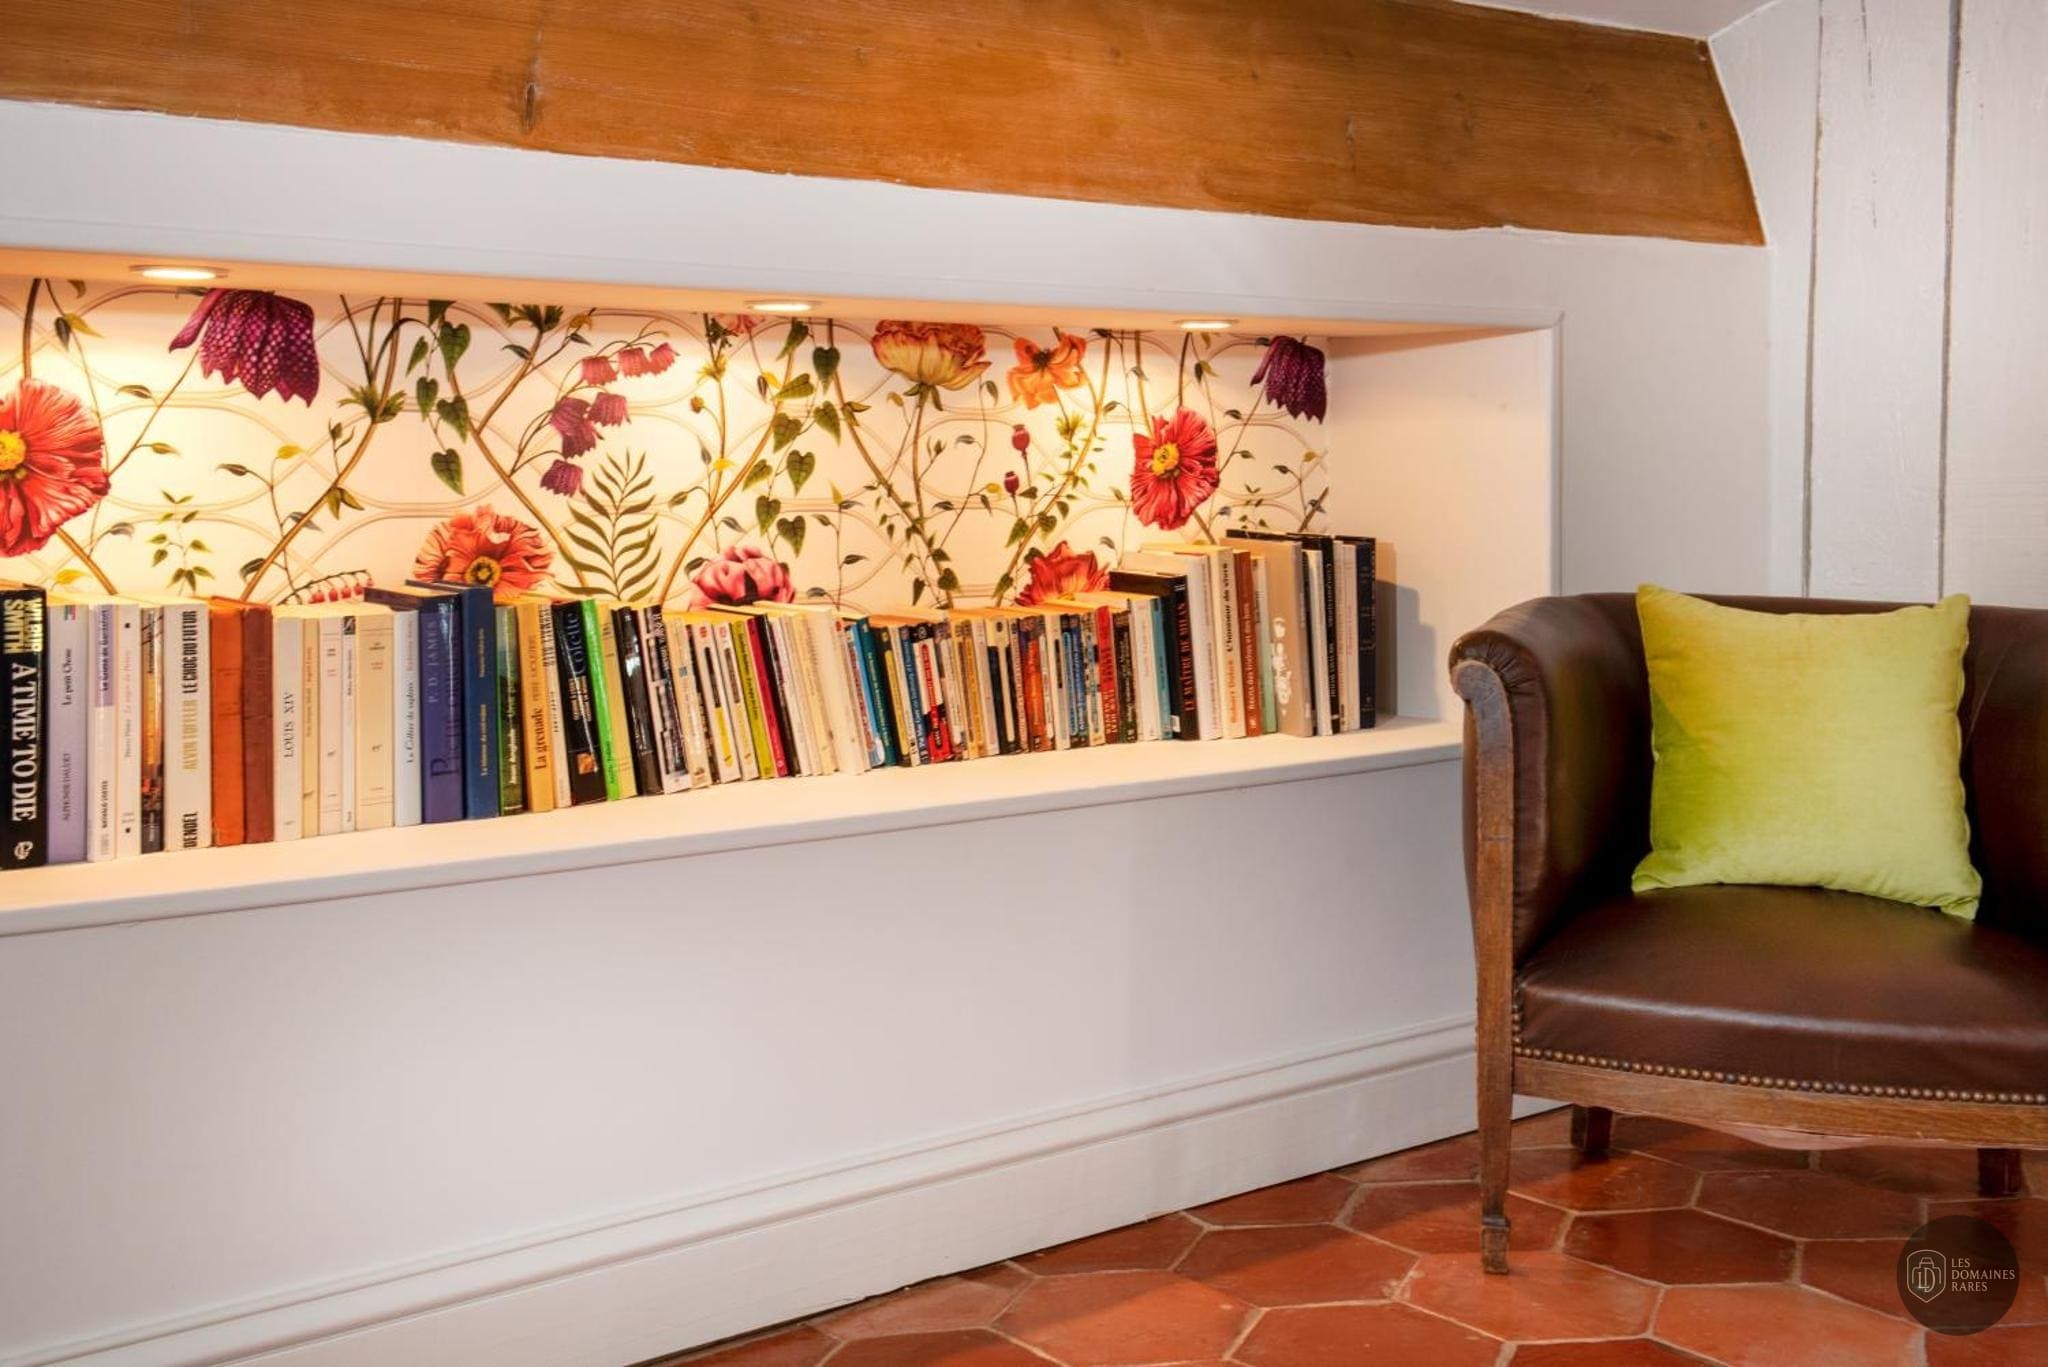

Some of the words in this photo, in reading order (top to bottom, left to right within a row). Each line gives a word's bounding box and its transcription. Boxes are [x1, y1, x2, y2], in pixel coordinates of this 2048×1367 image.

[3, 598, 24, 655] SMITH
[181, 610, 198, 643] FUTUR
[1223, 604, 1234, 653] L'honneur
[181, 643, 198, 656] DU
[426, 620, 439, 667] JAMES
[565, 612, 587, 676] Colette
[1180, 638, 1191, 653] DE
[11, 662, 37, 680] A
[181, 656, 198, 681] CHOC
[181, 682, 198, 695] LE
[283, 692, 294, 714] XIV
[11, 681, 38, 740] TIME
[181, 700, 198, 740] TOFFLER
[283, 721, 294, 758] LOUIS
[530, 707, 548, 753] grenade
[11, 745, 38, 778] TO
[181, 740, 198, 771] ALVIN
[533, 753, 547, 771] La
[11, 782, 38, 822] DIE
